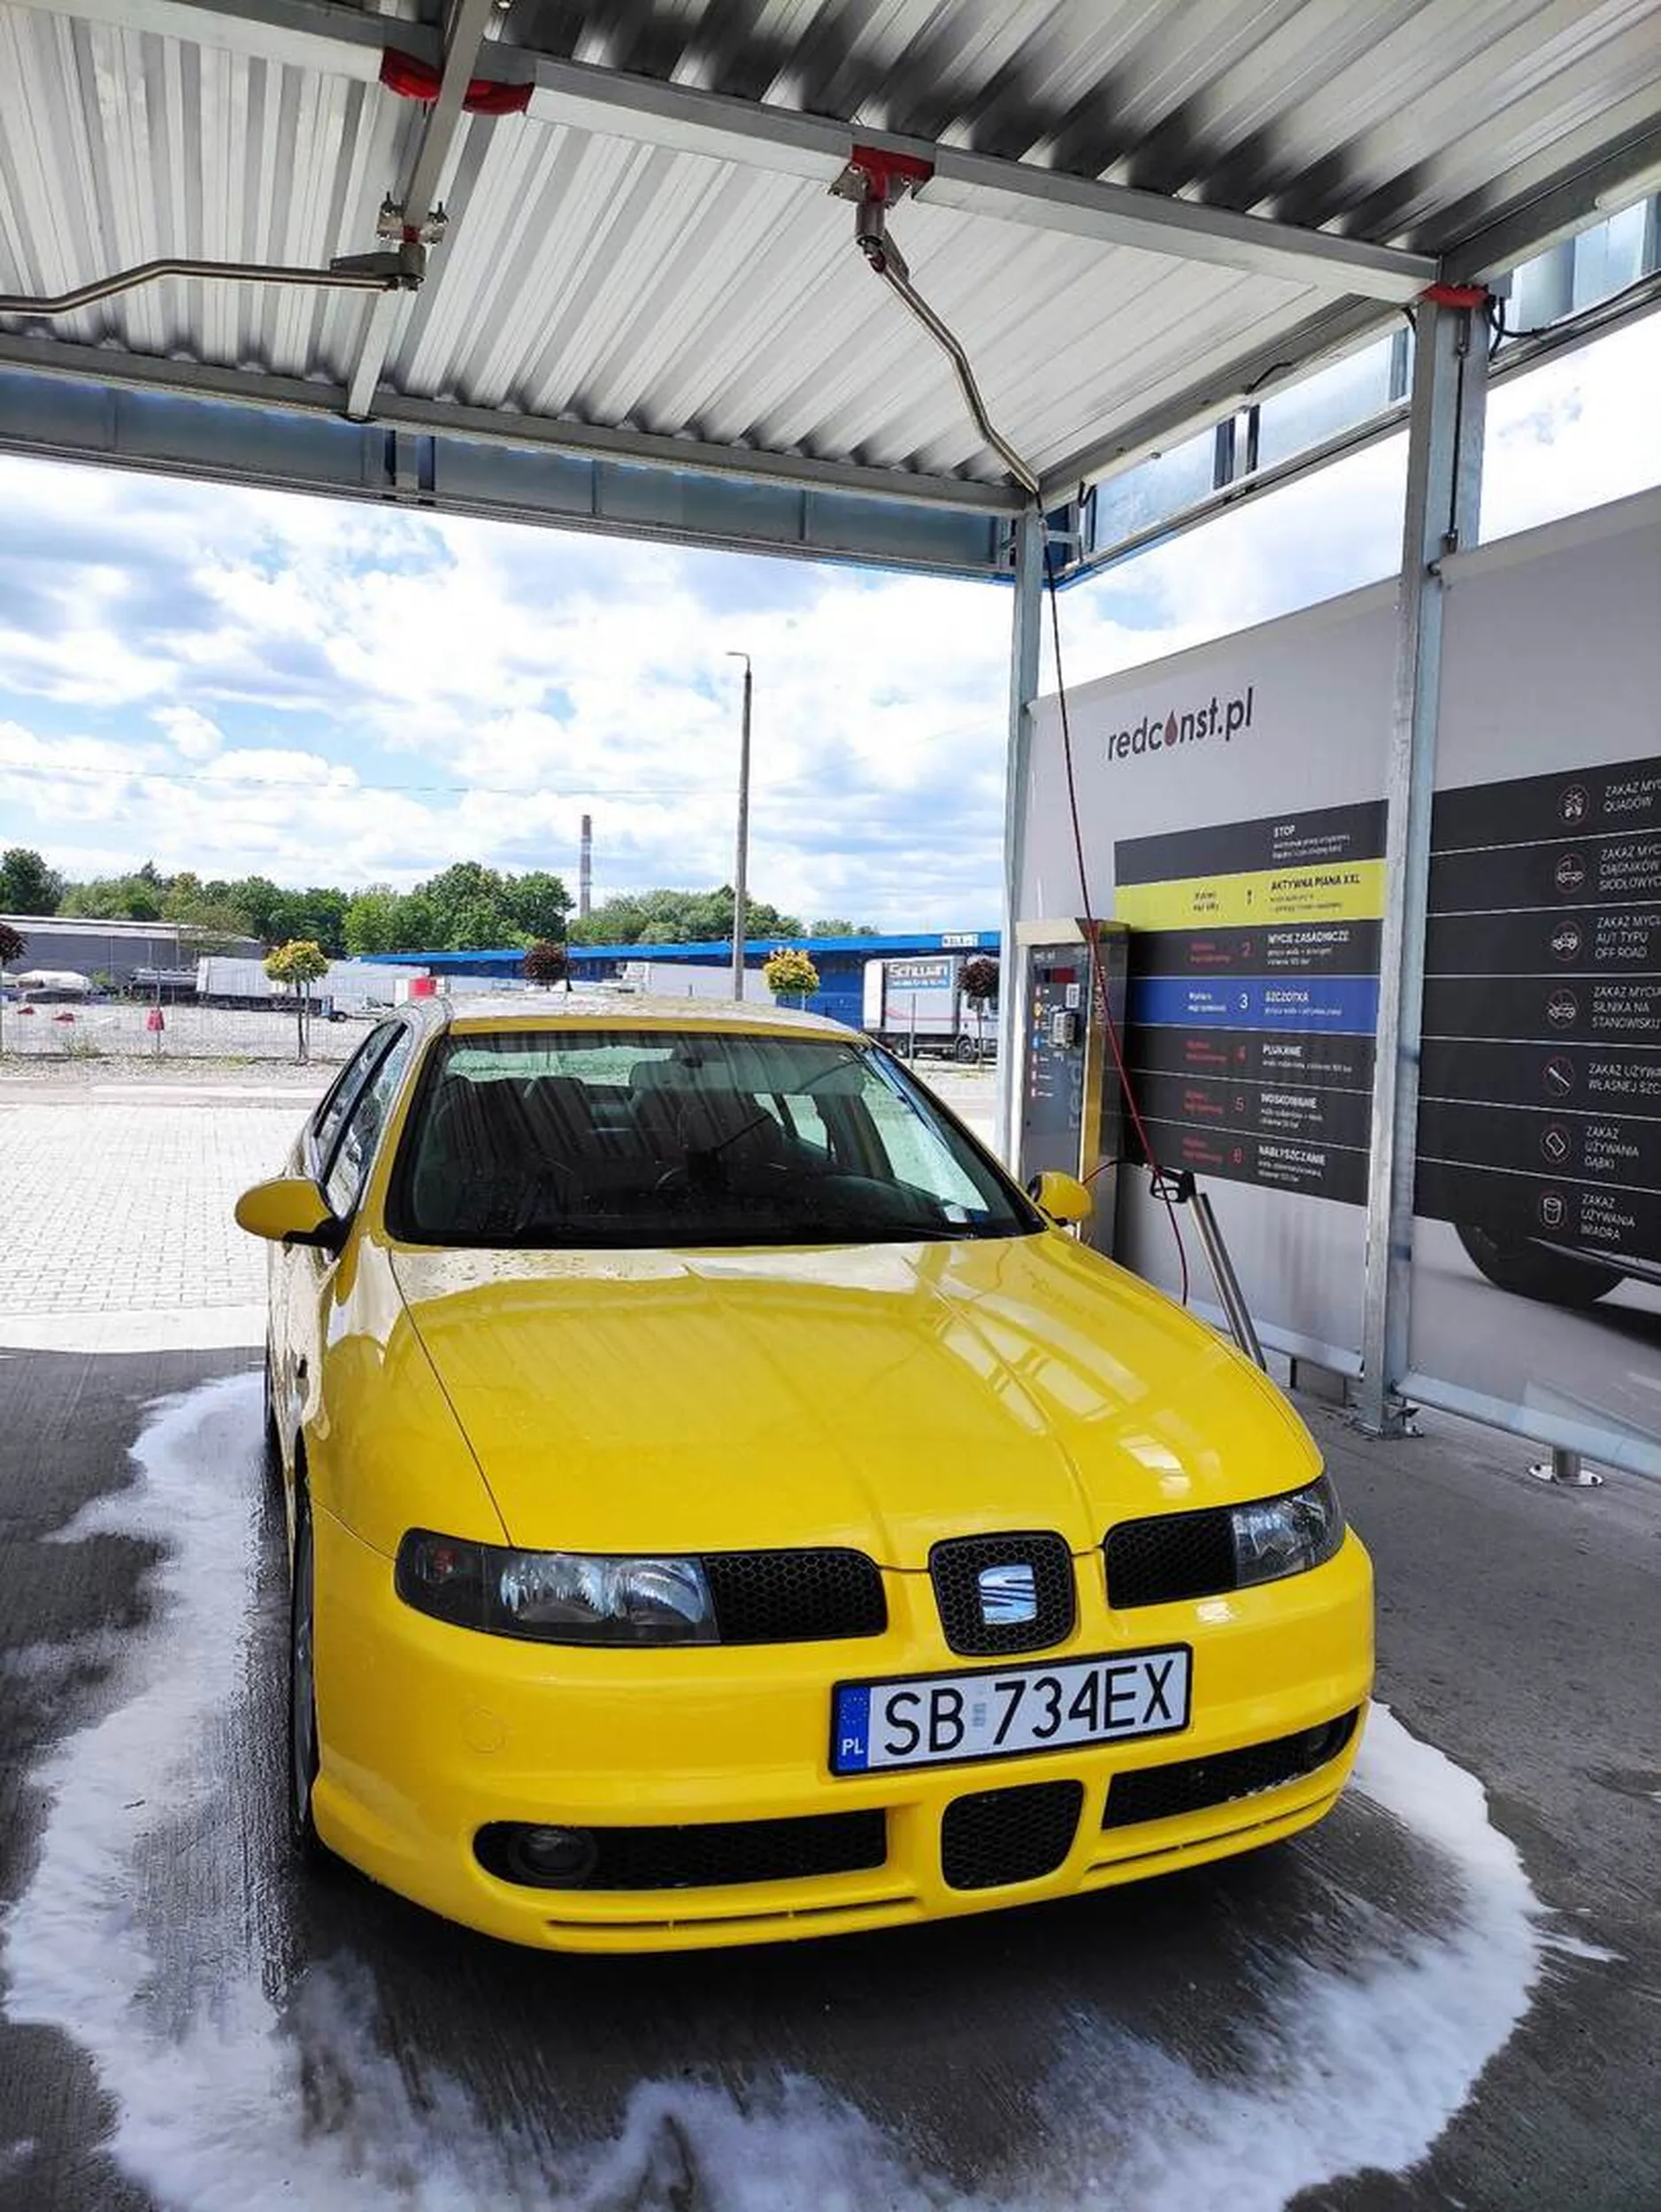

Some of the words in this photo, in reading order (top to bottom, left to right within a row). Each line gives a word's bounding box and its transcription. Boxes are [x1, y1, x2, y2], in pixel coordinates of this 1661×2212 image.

[1273, 825, 1295, 839] STOP
[1239, 992, 1249, 1009] 3
[884, 1687, 965, 1756] SB
[993, 1659, 1174, 1746] 734EX
[842, 1739, 865, 1756] PL
